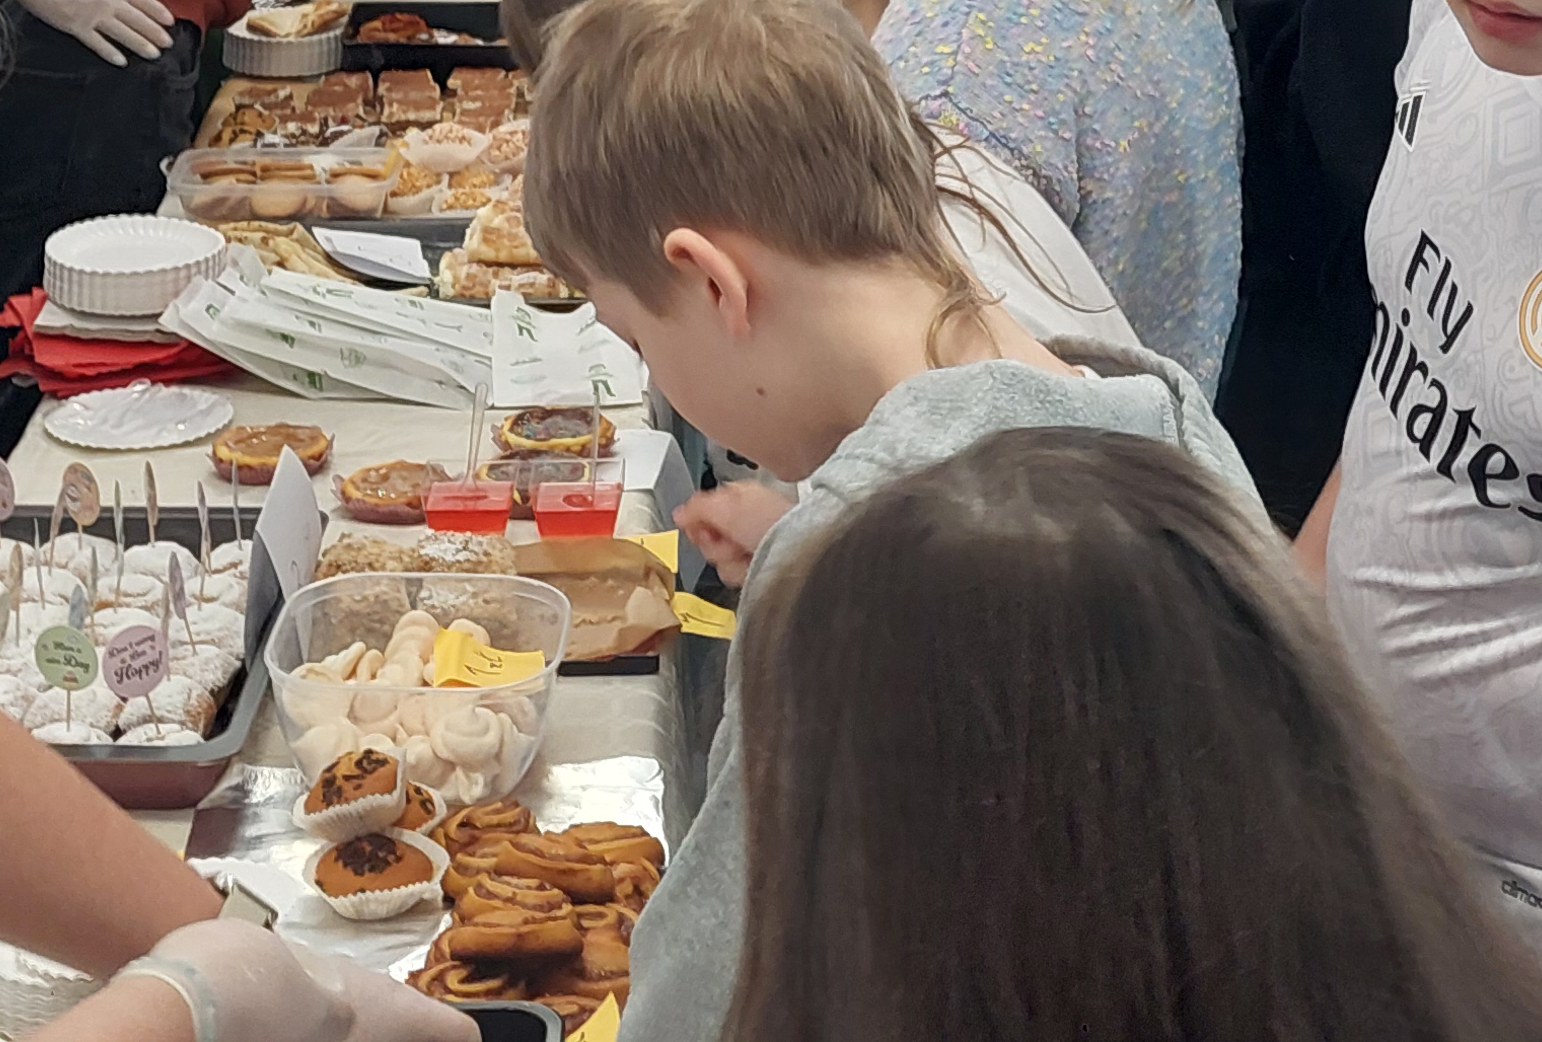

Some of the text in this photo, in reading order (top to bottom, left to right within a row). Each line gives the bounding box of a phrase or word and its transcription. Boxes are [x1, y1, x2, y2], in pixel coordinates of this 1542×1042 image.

[1404, 228, 1474, 355] Fly
[62, 654, 90, 674] Day
[114, 650, 164, 685] Happy!
